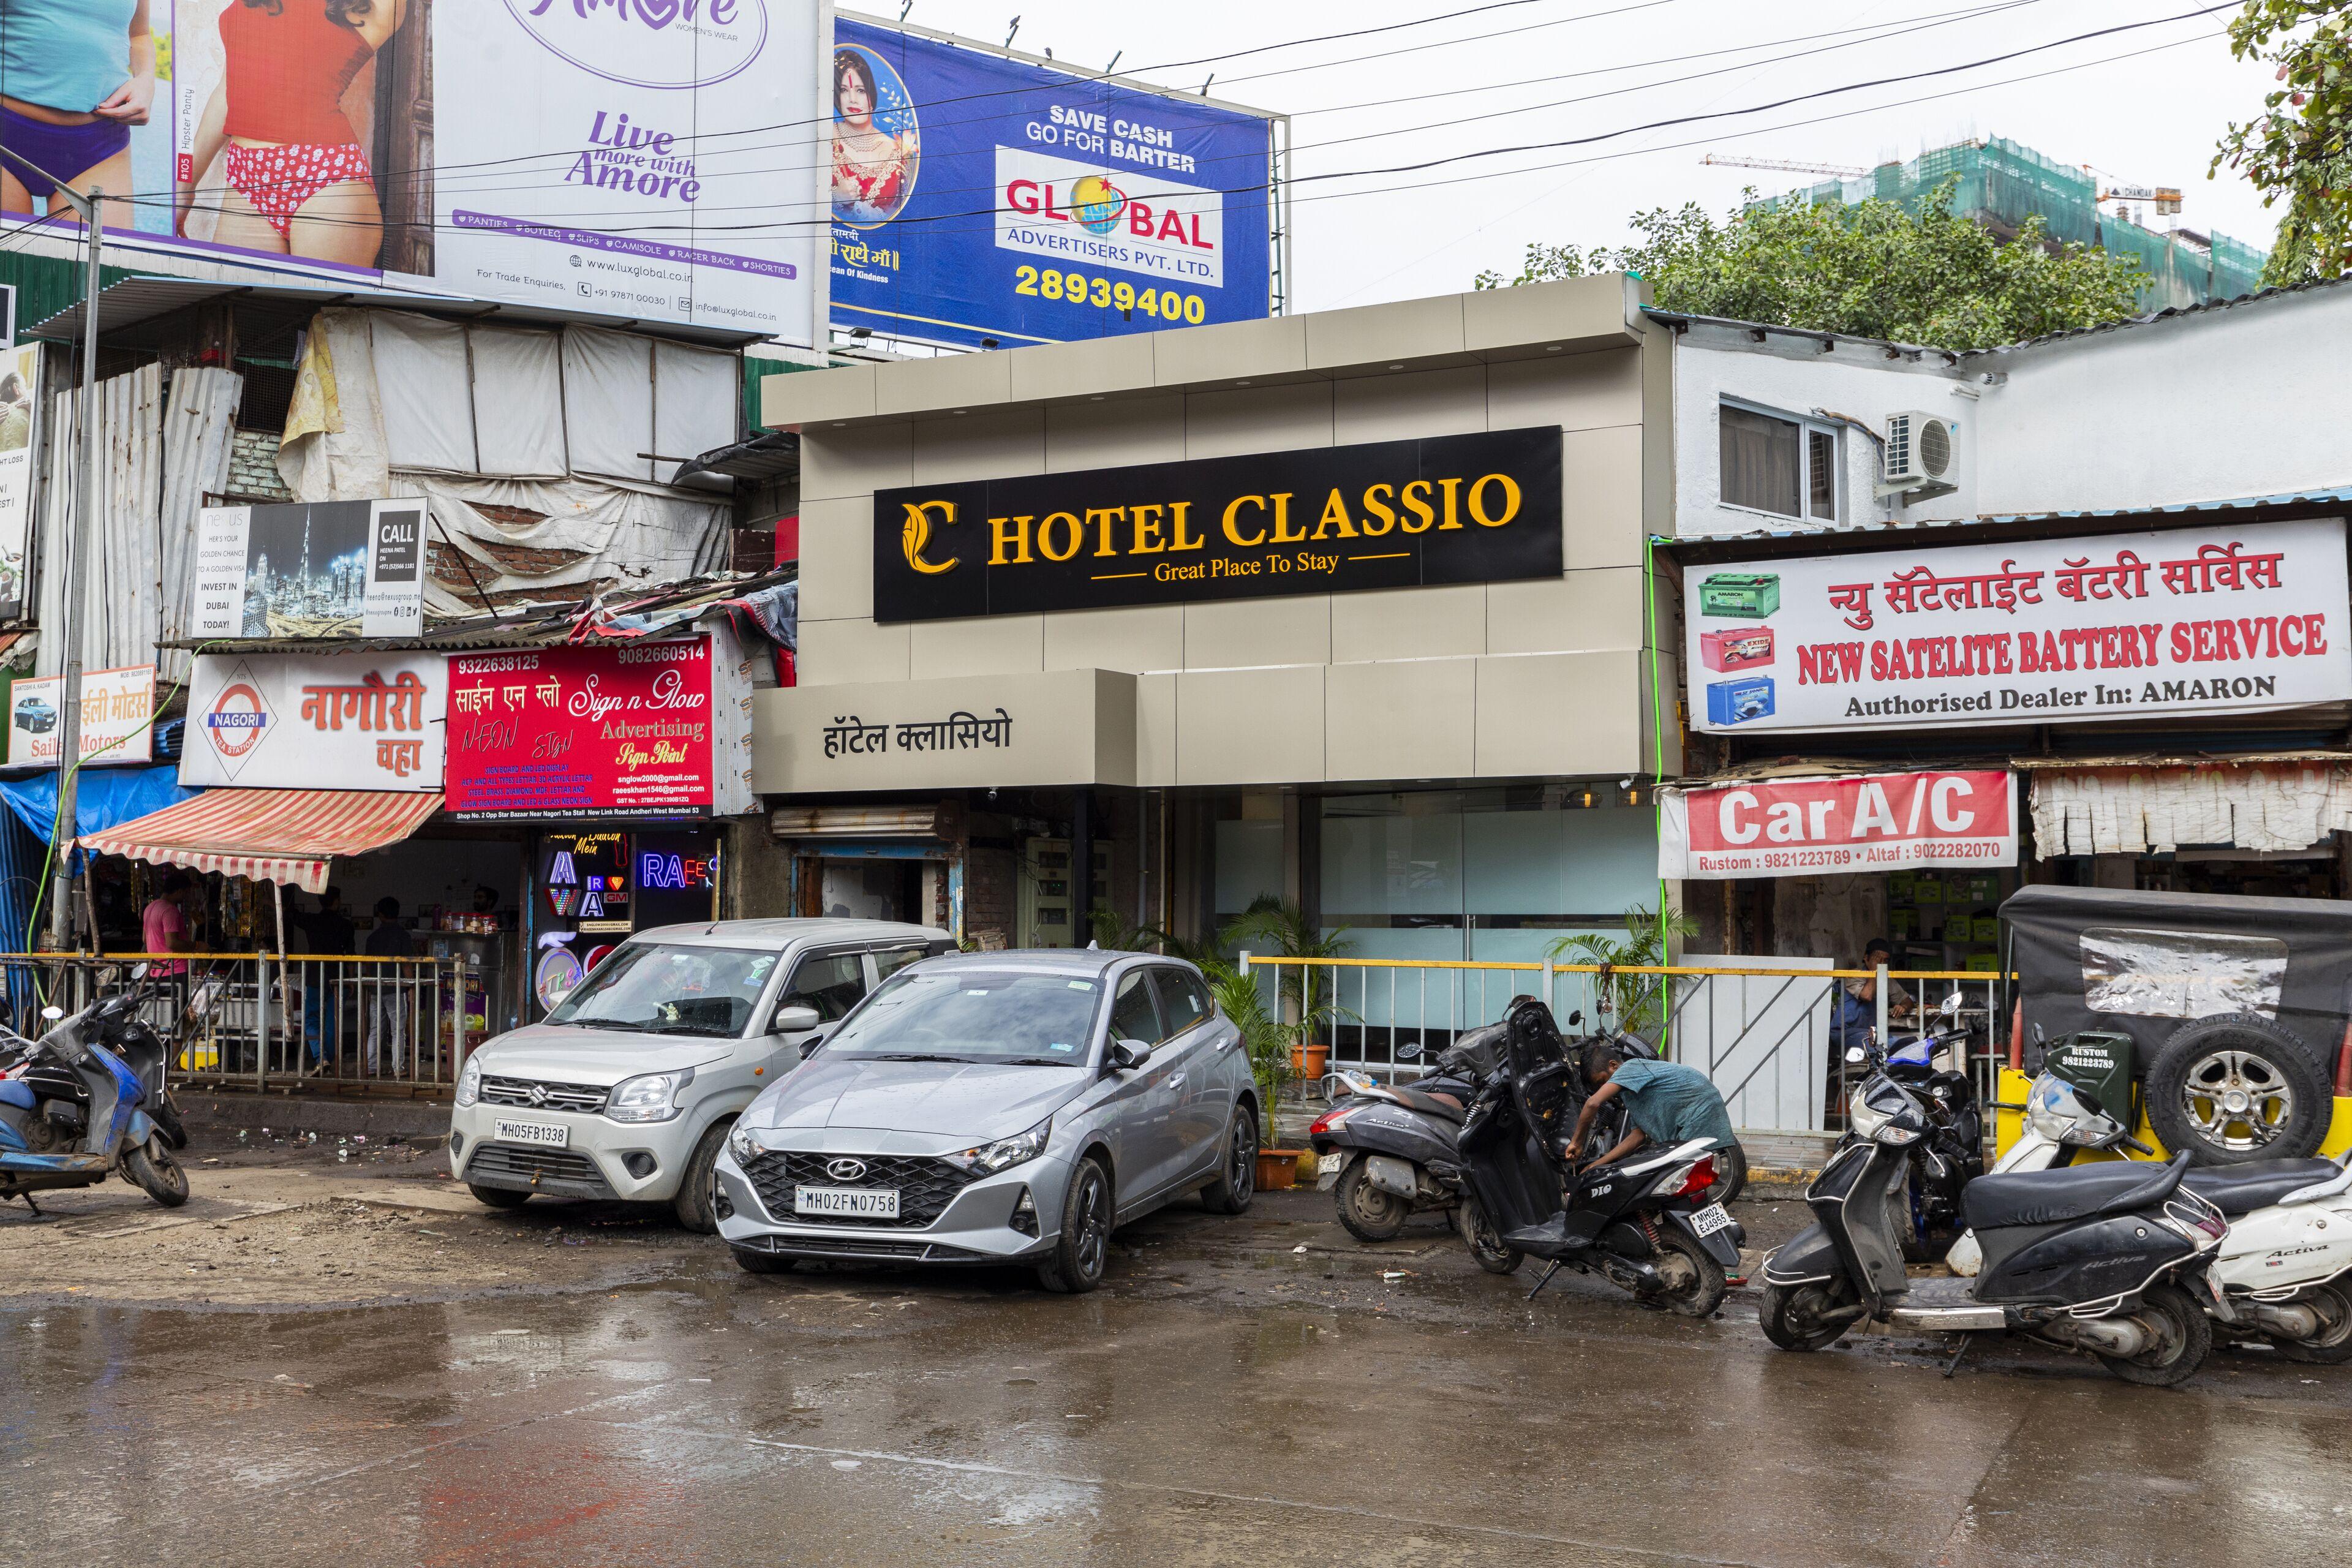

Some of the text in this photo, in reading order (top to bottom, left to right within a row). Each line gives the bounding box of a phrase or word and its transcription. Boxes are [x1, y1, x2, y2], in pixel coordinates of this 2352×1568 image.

[675, 23, 738, 42] WOMEN'S WEAR
[182, 89, 194, 149] Hipster Panty
[1050, 105, 1172, 148] SAVE CASH
[588, 110, 674, 155] Live
[1026, 122, 1195, 173] GO FOR BARTER
[181, 159, 189, 179] #105
[594, 148, 696, 177] more with
[564, 152, 701, 203] Amore
[468, 216, 508, 227] PANTIES
[524, 226, 560, 240] BOYLEG
[614, 240, 662, 255] CAMISOLE
[677, 250, 708, 262] RACER
[711, 255, 735, 266] BACK
[750, 262, 790, 275] SHORTIES
[1008, 228, 1213, 277] ADVERTISERS PVT. LTD.
[477, 270, 565, 290] For Trade Enquiries,
[587, 259, 693, 283] www.luxglobal.co.in
[846, 268, 888, 283] Of Kindness
[611, 290, 633, 300] 97871
[636, 294, 665, 305] 00030
[1015, 265, 1205, 324] 28939400
[696, 302, 777, 321] info@luxglobal.co.in
[8, 455, 23, 464] LOSS
[988, 473, 1521, 565] HOTEL CLASSIO
[381, 524, 413, 543] CALL
[1155, 552, 1340, 581] Great Place To Stay
[1828, 541, 2284, 631] न्यु सॅटेलाईट बॅटरी सर्विस
[618, 644, 704, 665] 9082660514
[1797, 612, 2327, 685] NEW SATELITE BATTERY SERVICE
[459, 655, 538, 674] 9322638125
[112, 682, 151, 720] मोटर्स
[302, 670, 426, 731] नागौरी
[455, 675, 561, 715] साईन एन ग्लो
[568, 674, 624, 722] Sign
[627, 696, 643, 709] n
[646, 669, 704, 709] Glow
[1845, 675, 2276, 717] Authorised Dealer In: AMARON
[215, 714, 258, 726] NAGORI
[600, 718, 704, 742] Advertising
[80, 733, 126, 752] Motors
[216, 736, 254, 754] TEA STATION
[462, 716, 519, 753] NEON
[823, 707, 1012, 759] हॉटेल क्लासियो
[377, 739, 423, 777] चहा
[615, 741, 688, 772] Sign Point
[612, 785, 704, 794] raeeskhan1546@gmail.com
[617, 774, 699, 784] snglow2000@gmail.com
[1719, 776, 1975, 845] Car A/C
[574, 837, 597, 854] Mein
[1699, 842, 2000, 870] Rustom 9821223789 Altaf 9022282070
[2062, 1056, 2114, 1069] 9821223789
[2071, 1048, 2108, 1057] RUSTOM
[502, 1123, 564, 1142] MH05FB1338
[807, 1193, 895, 1212] MH02FN0758
[1591, 1184, 1611, 1197] DIO
[1697, 1207, 1719, 1223] MH02
[1698, 1214, 1727, 1233] EJ4955
[2081, 1254, 2147, 1271] Activa
[2267, 1244, 2330, 1259] Activa
